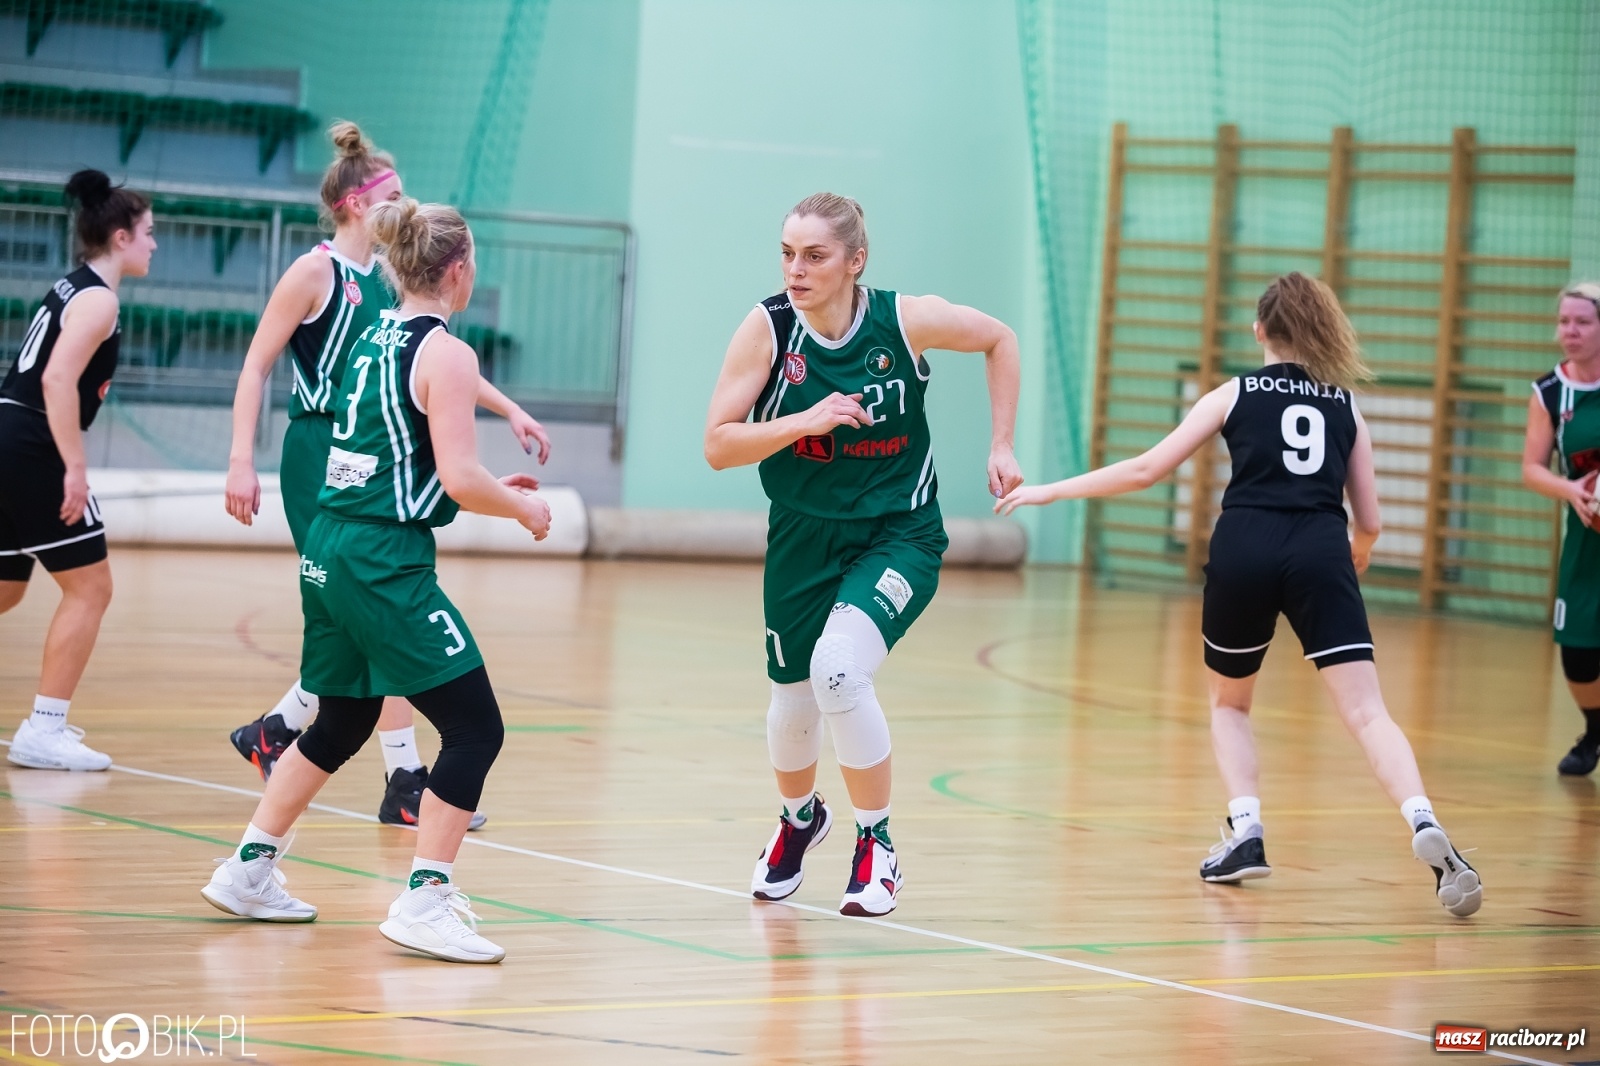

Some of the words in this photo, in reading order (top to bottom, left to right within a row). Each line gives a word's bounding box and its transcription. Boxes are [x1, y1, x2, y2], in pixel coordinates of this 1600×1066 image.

[332, 355, 373, 441] 3
[863, 378, 907, 424] 27
[1244, 375, 1347, 405] BOCHNIA
[1280, 403, 1326, 476] 9
[427, 609, 467, 657] 3
[766, 626, 786, 668] 7
